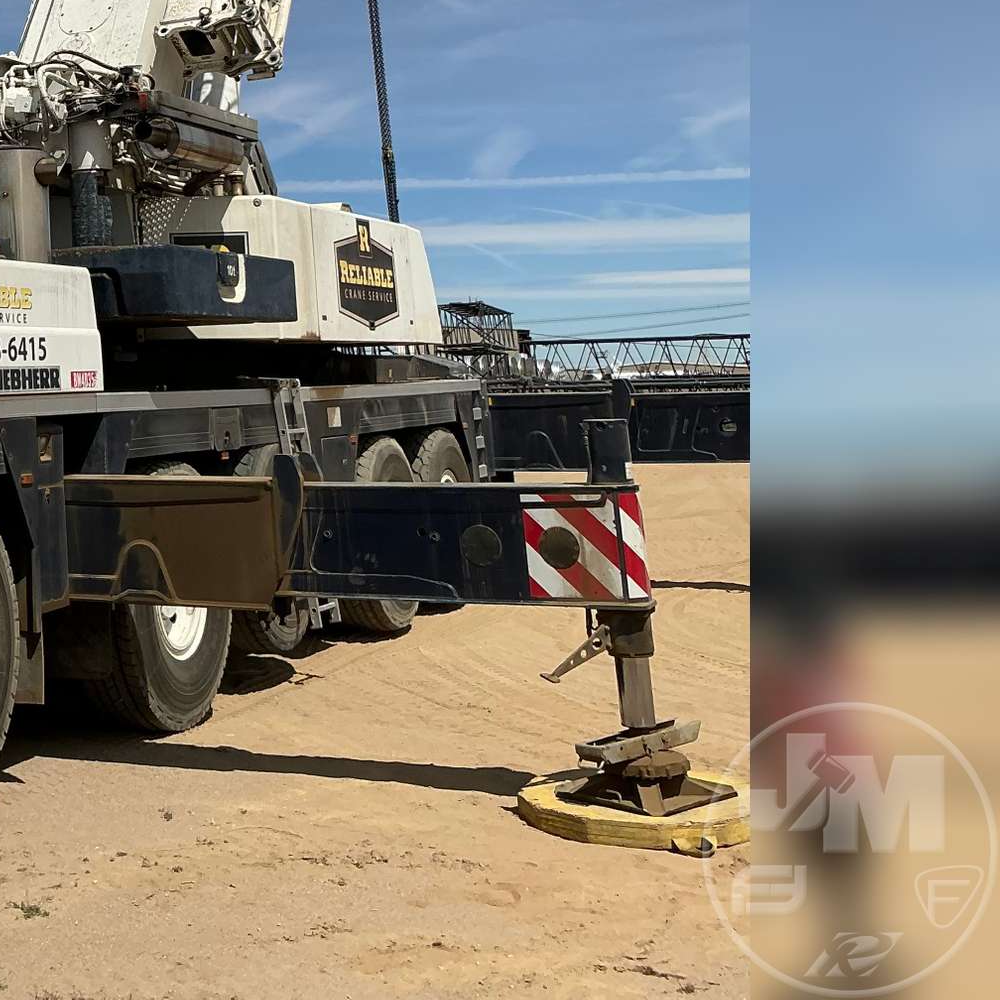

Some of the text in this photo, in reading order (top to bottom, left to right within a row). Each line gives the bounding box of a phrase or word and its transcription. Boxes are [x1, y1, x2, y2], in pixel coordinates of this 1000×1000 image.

[339, 260, 394, 288] RELIABLE
[345, 288, 393, 303] CRANE SERVICE
